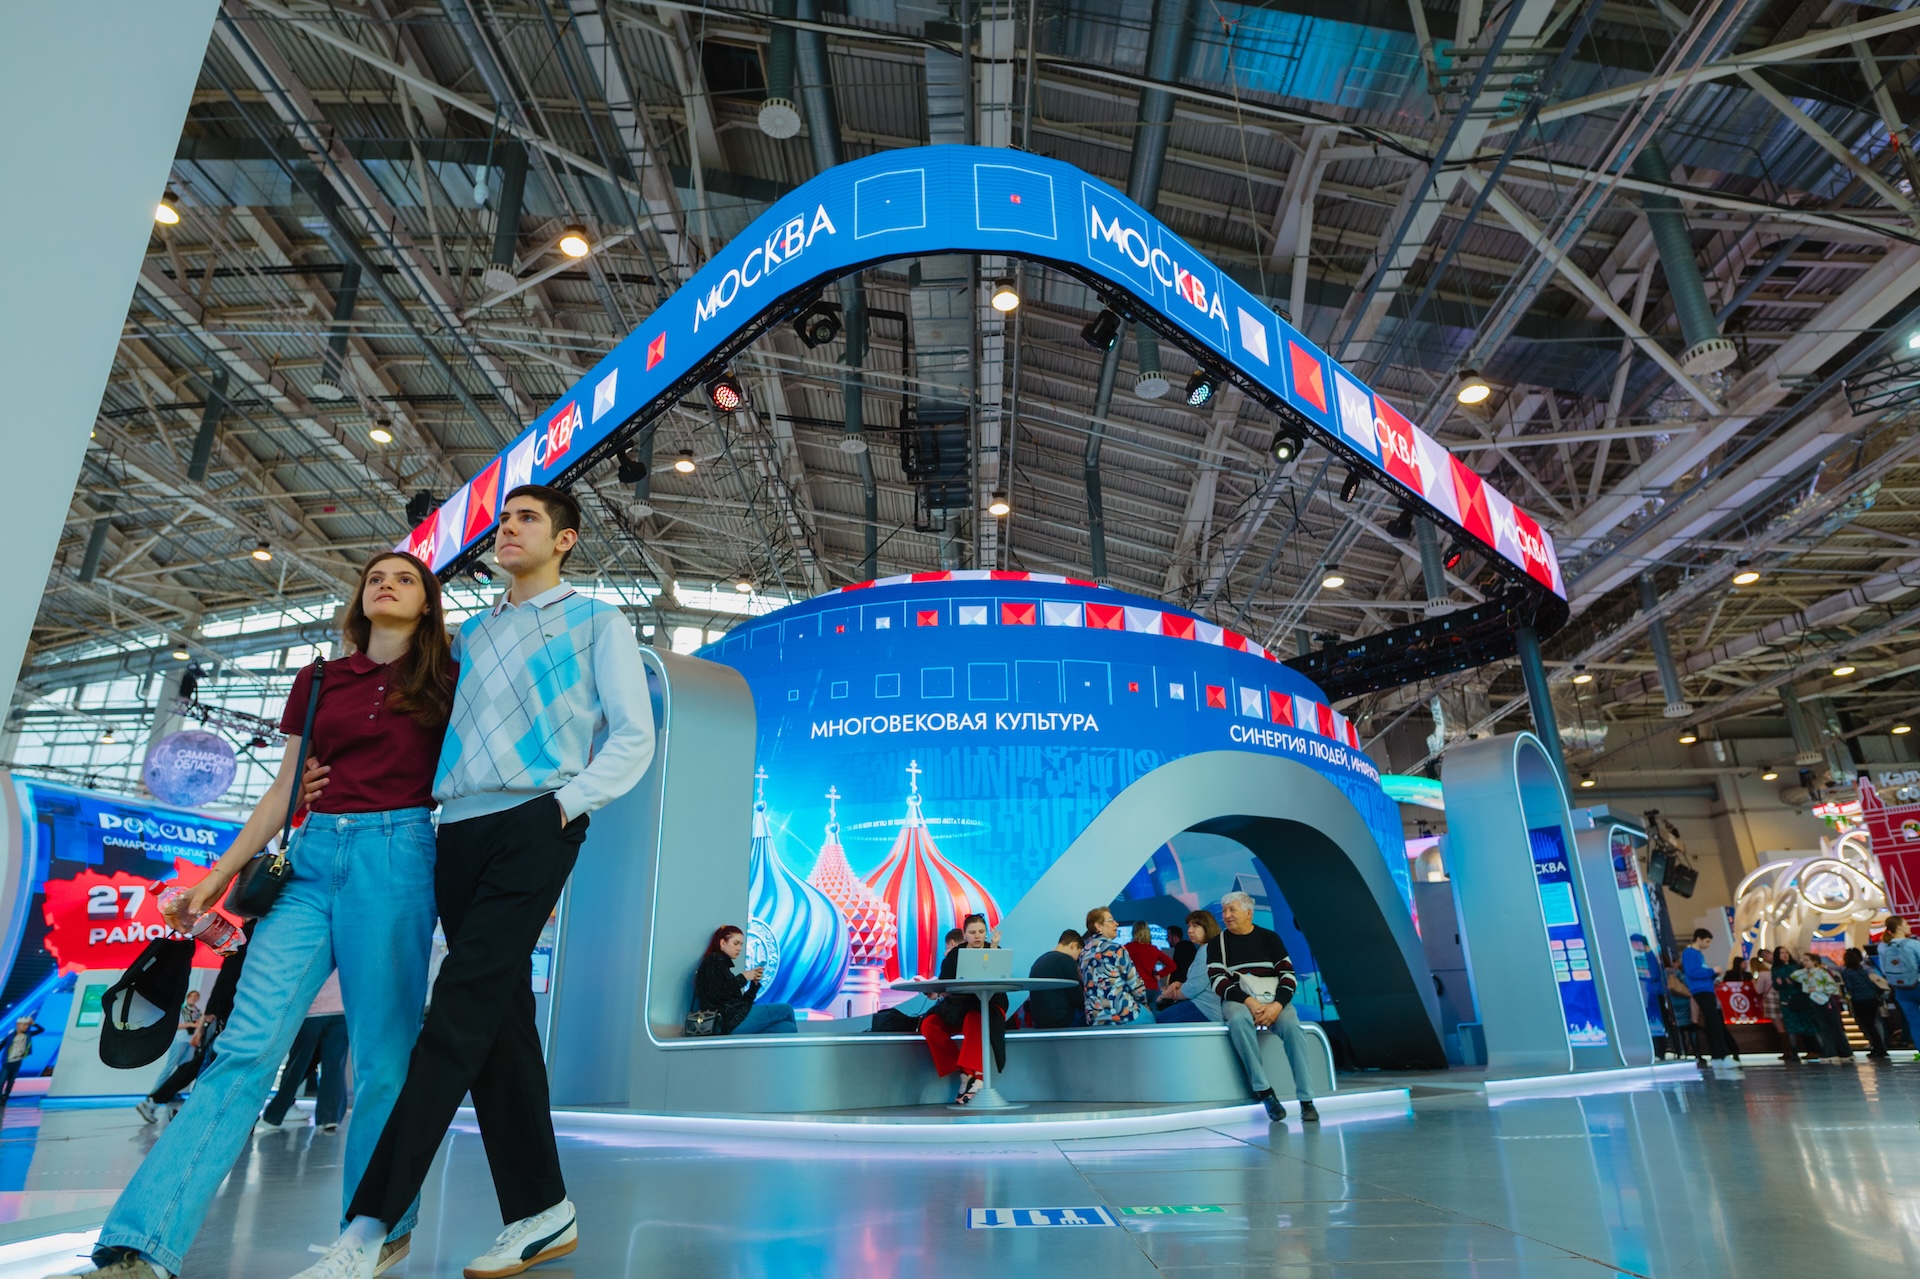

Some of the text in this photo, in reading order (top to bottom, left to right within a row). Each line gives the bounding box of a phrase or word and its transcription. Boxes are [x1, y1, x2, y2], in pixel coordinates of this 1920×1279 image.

[693, 203, 836, 333] МОСКВА
[1091, 205, 1229, 331] МОСКВА
[503, 404, 583, 491] МОСКВА
[1340, 387, 1422, 472] МОСКВА
[811, 712, 1099, 739] МНОГОВЕКОВАЯ КУЛЬТУРА
[1229, 724, 1307, 755] СИНЕРГИЯ
[1309, 741, 1350, 771] ЛЮДЕЙ,
[174, 758, 223, 775] ОБЛАСТЬ
[102, 836, 172, 854] САМАРСКАЯ
[87, 885, 146, 920] 27
